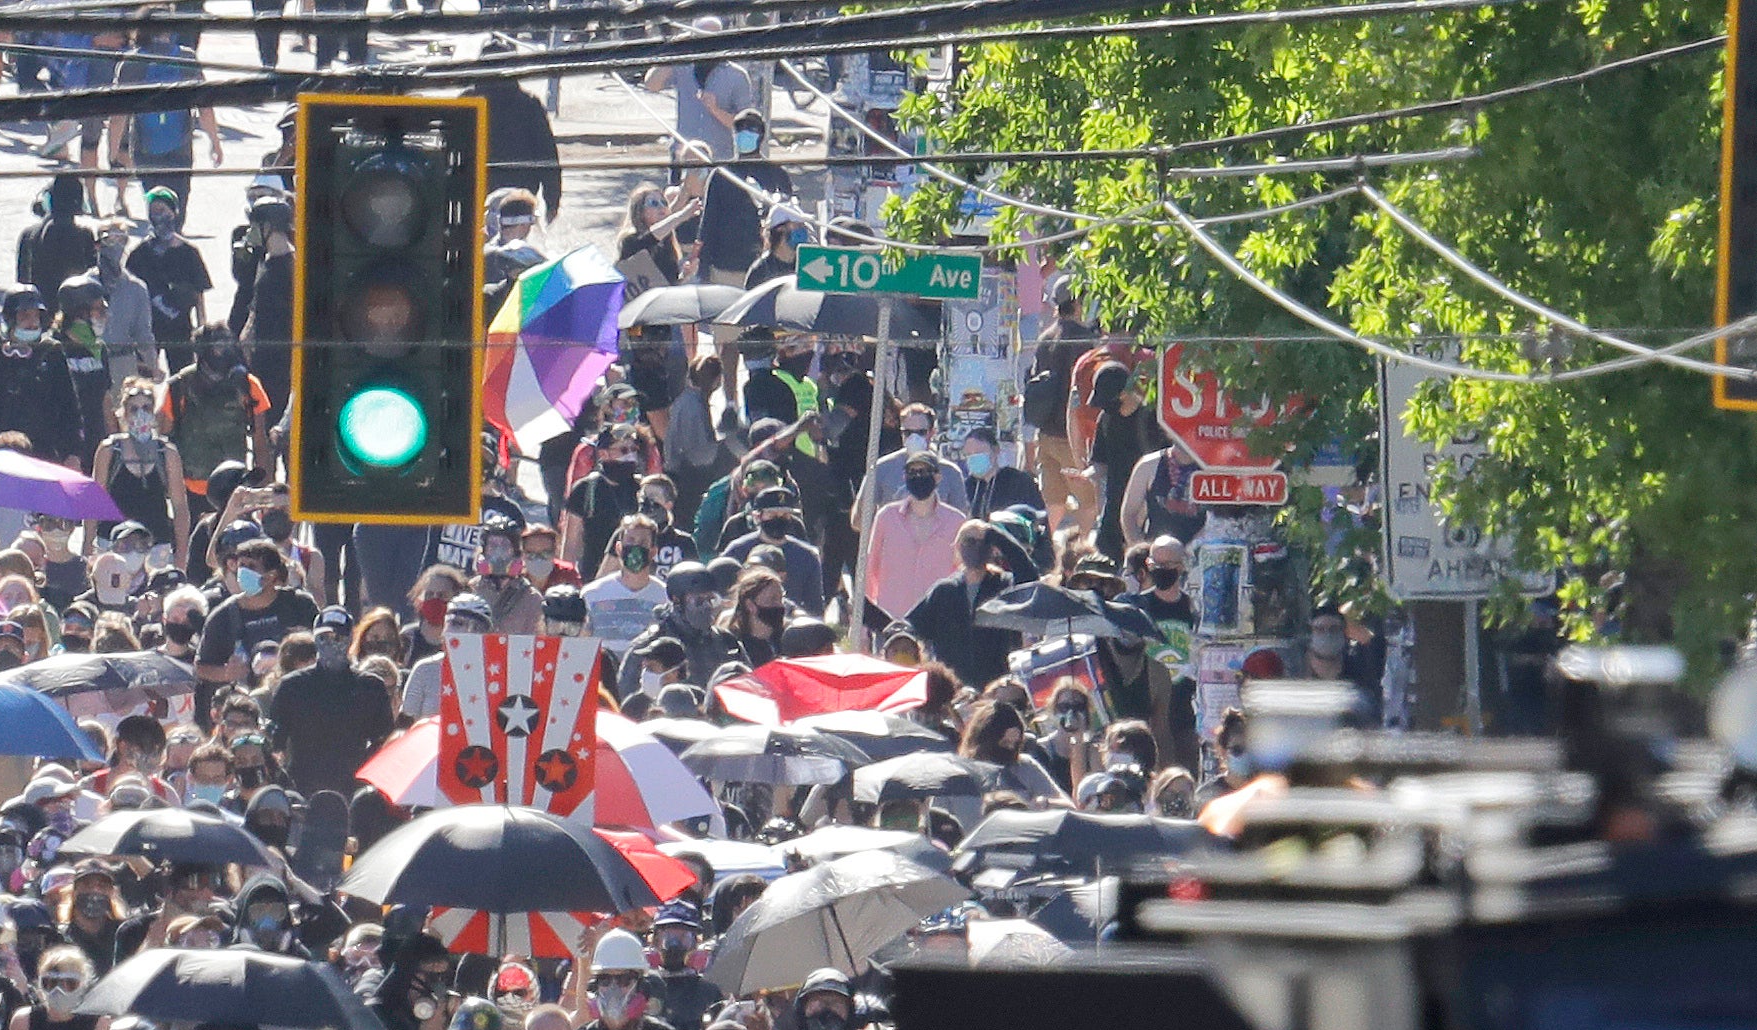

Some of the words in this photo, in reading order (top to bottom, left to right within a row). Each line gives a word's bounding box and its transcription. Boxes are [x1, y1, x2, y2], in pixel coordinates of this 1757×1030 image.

[929, 263, 973, 289] Ave
[1198, 479, 1232, 497] ALL
[1245, 479, 1278, 497] WAY
